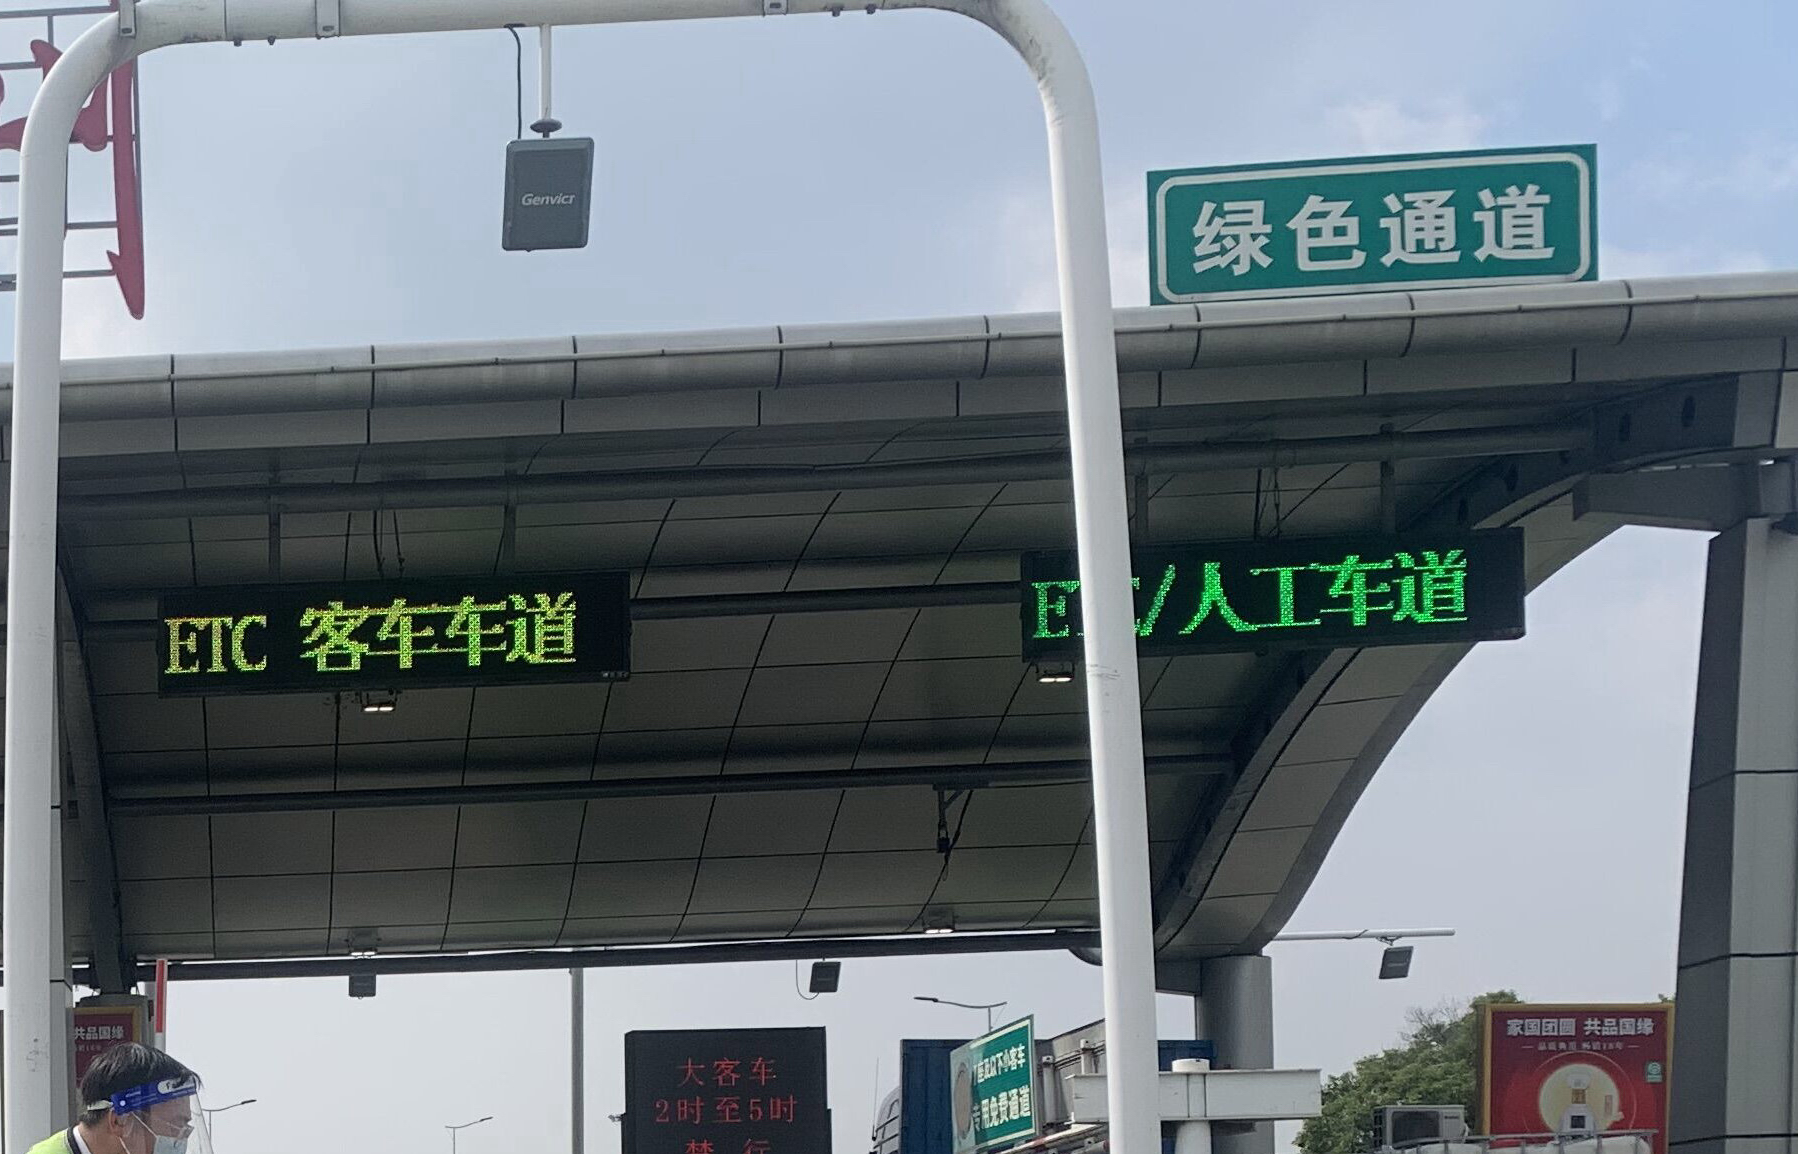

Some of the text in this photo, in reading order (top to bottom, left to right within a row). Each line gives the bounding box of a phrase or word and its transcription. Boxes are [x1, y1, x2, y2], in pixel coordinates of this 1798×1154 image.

[1192, 183, 1555, 276] 绿色通道
[1030, 549, 1467, 639] E/人工车道
[164, 592, 576, 673] ETC 客车车道
[74, 1025, 125, 1040] 共品国缘
[1507, 1017, 1655, 1036] 家国团圆 共品国缘
[676, 1056, 777, 1087] 大客车
[655, 1094, 799, 1126] 2时至5时
